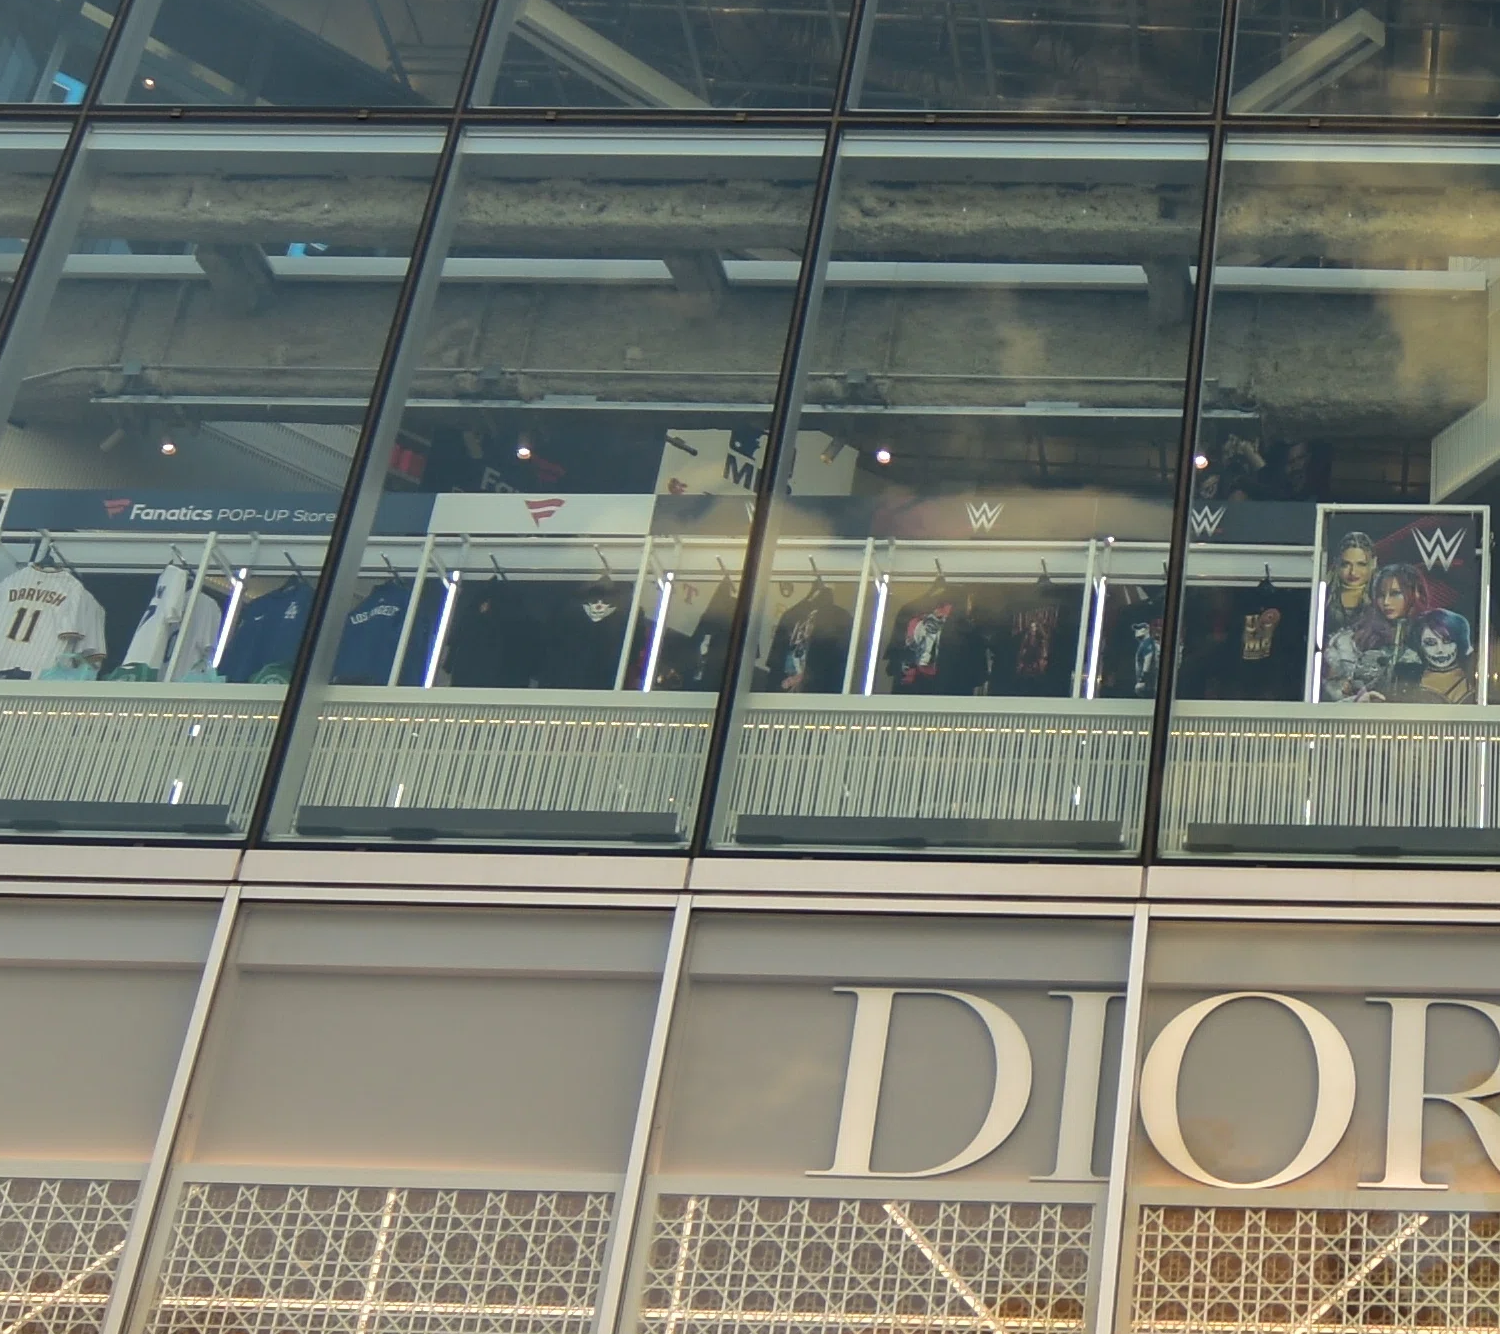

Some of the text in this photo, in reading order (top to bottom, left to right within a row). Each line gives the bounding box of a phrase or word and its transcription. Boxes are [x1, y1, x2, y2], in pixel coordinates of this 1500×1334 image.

[130, 504, 337, 523] Fanatics POP-UP Store
[8, 587, 67, 607] DARVISH
[7, 607, 42, 643] 11
